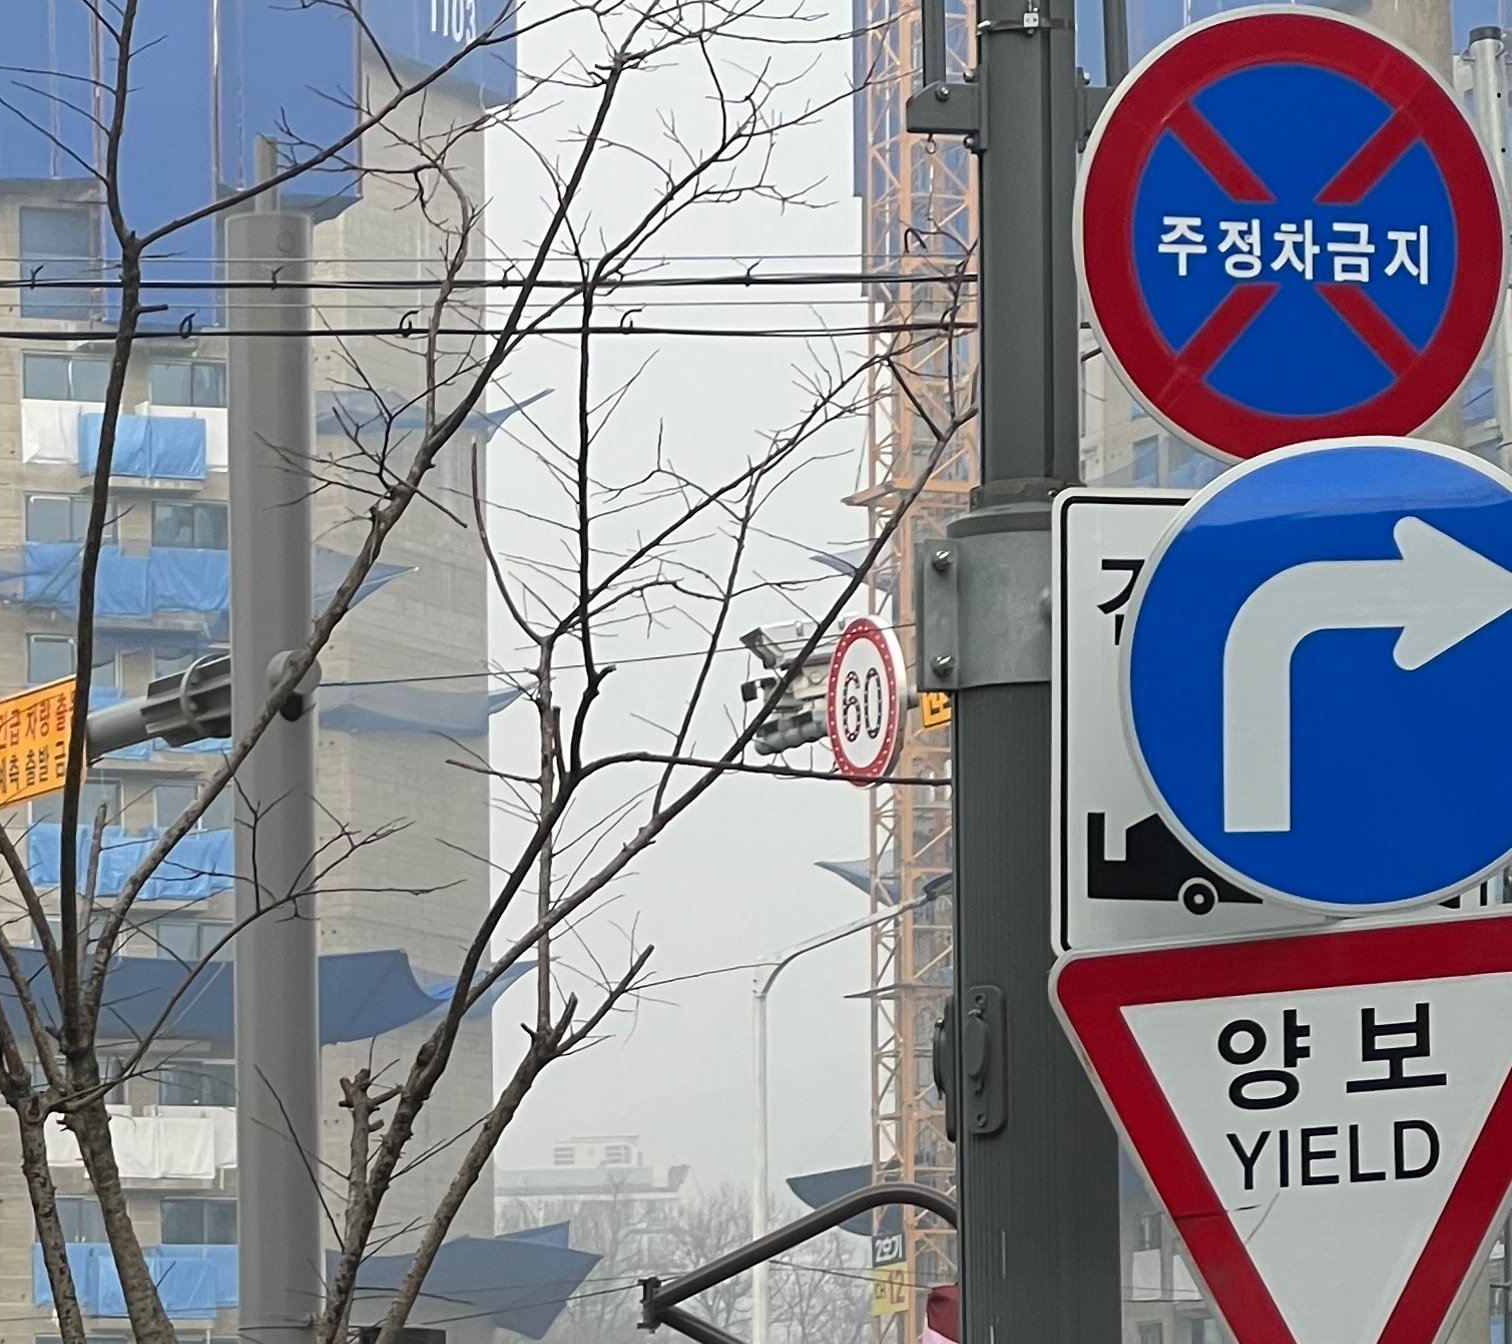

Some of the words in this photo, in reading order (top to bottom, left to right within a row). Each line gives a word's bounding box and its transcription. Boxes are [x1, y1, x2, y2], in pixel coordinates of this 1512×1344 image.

[1158, 215, 1429, 284] 주정차금지
[843, 667, 882, 742] 60
[1226, 1119, 1441, 1191] YIELD
